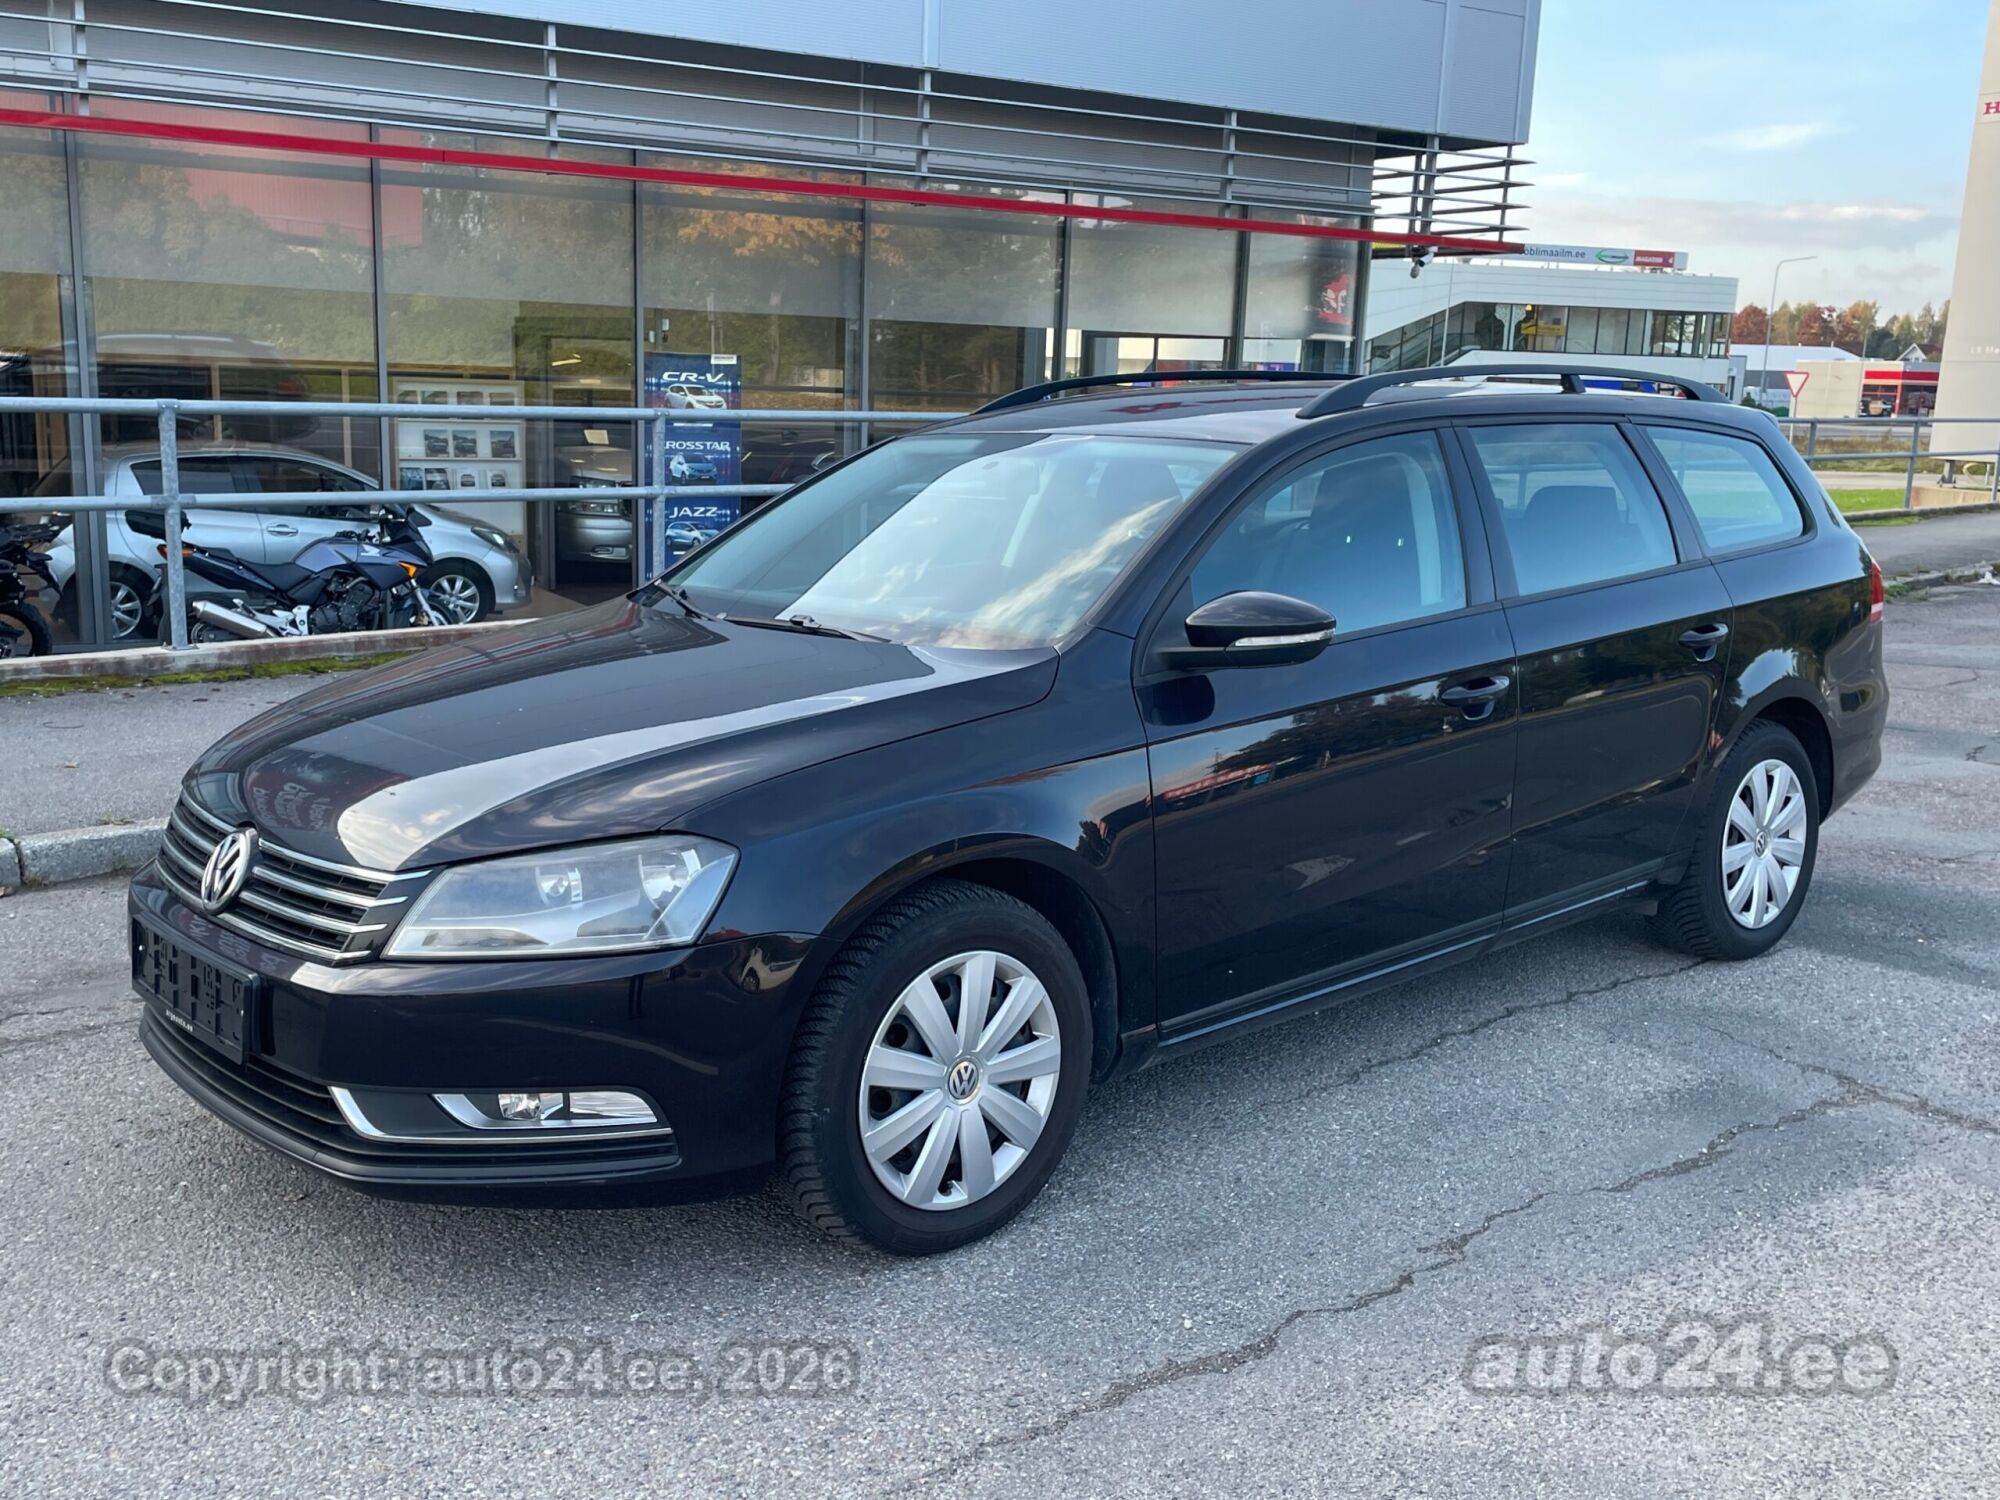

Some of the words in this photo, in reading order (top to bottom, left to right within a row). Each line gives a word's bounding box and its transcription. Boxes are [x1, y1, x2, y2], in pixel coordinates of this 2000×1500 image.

[1522, 246, 1586, 258] oblimaailm.ee
[662, 372, 724, 382] CR-V
[664, 441, 730, 450] ROSSTAR
[669, 507, 718, 518] JAZZ
